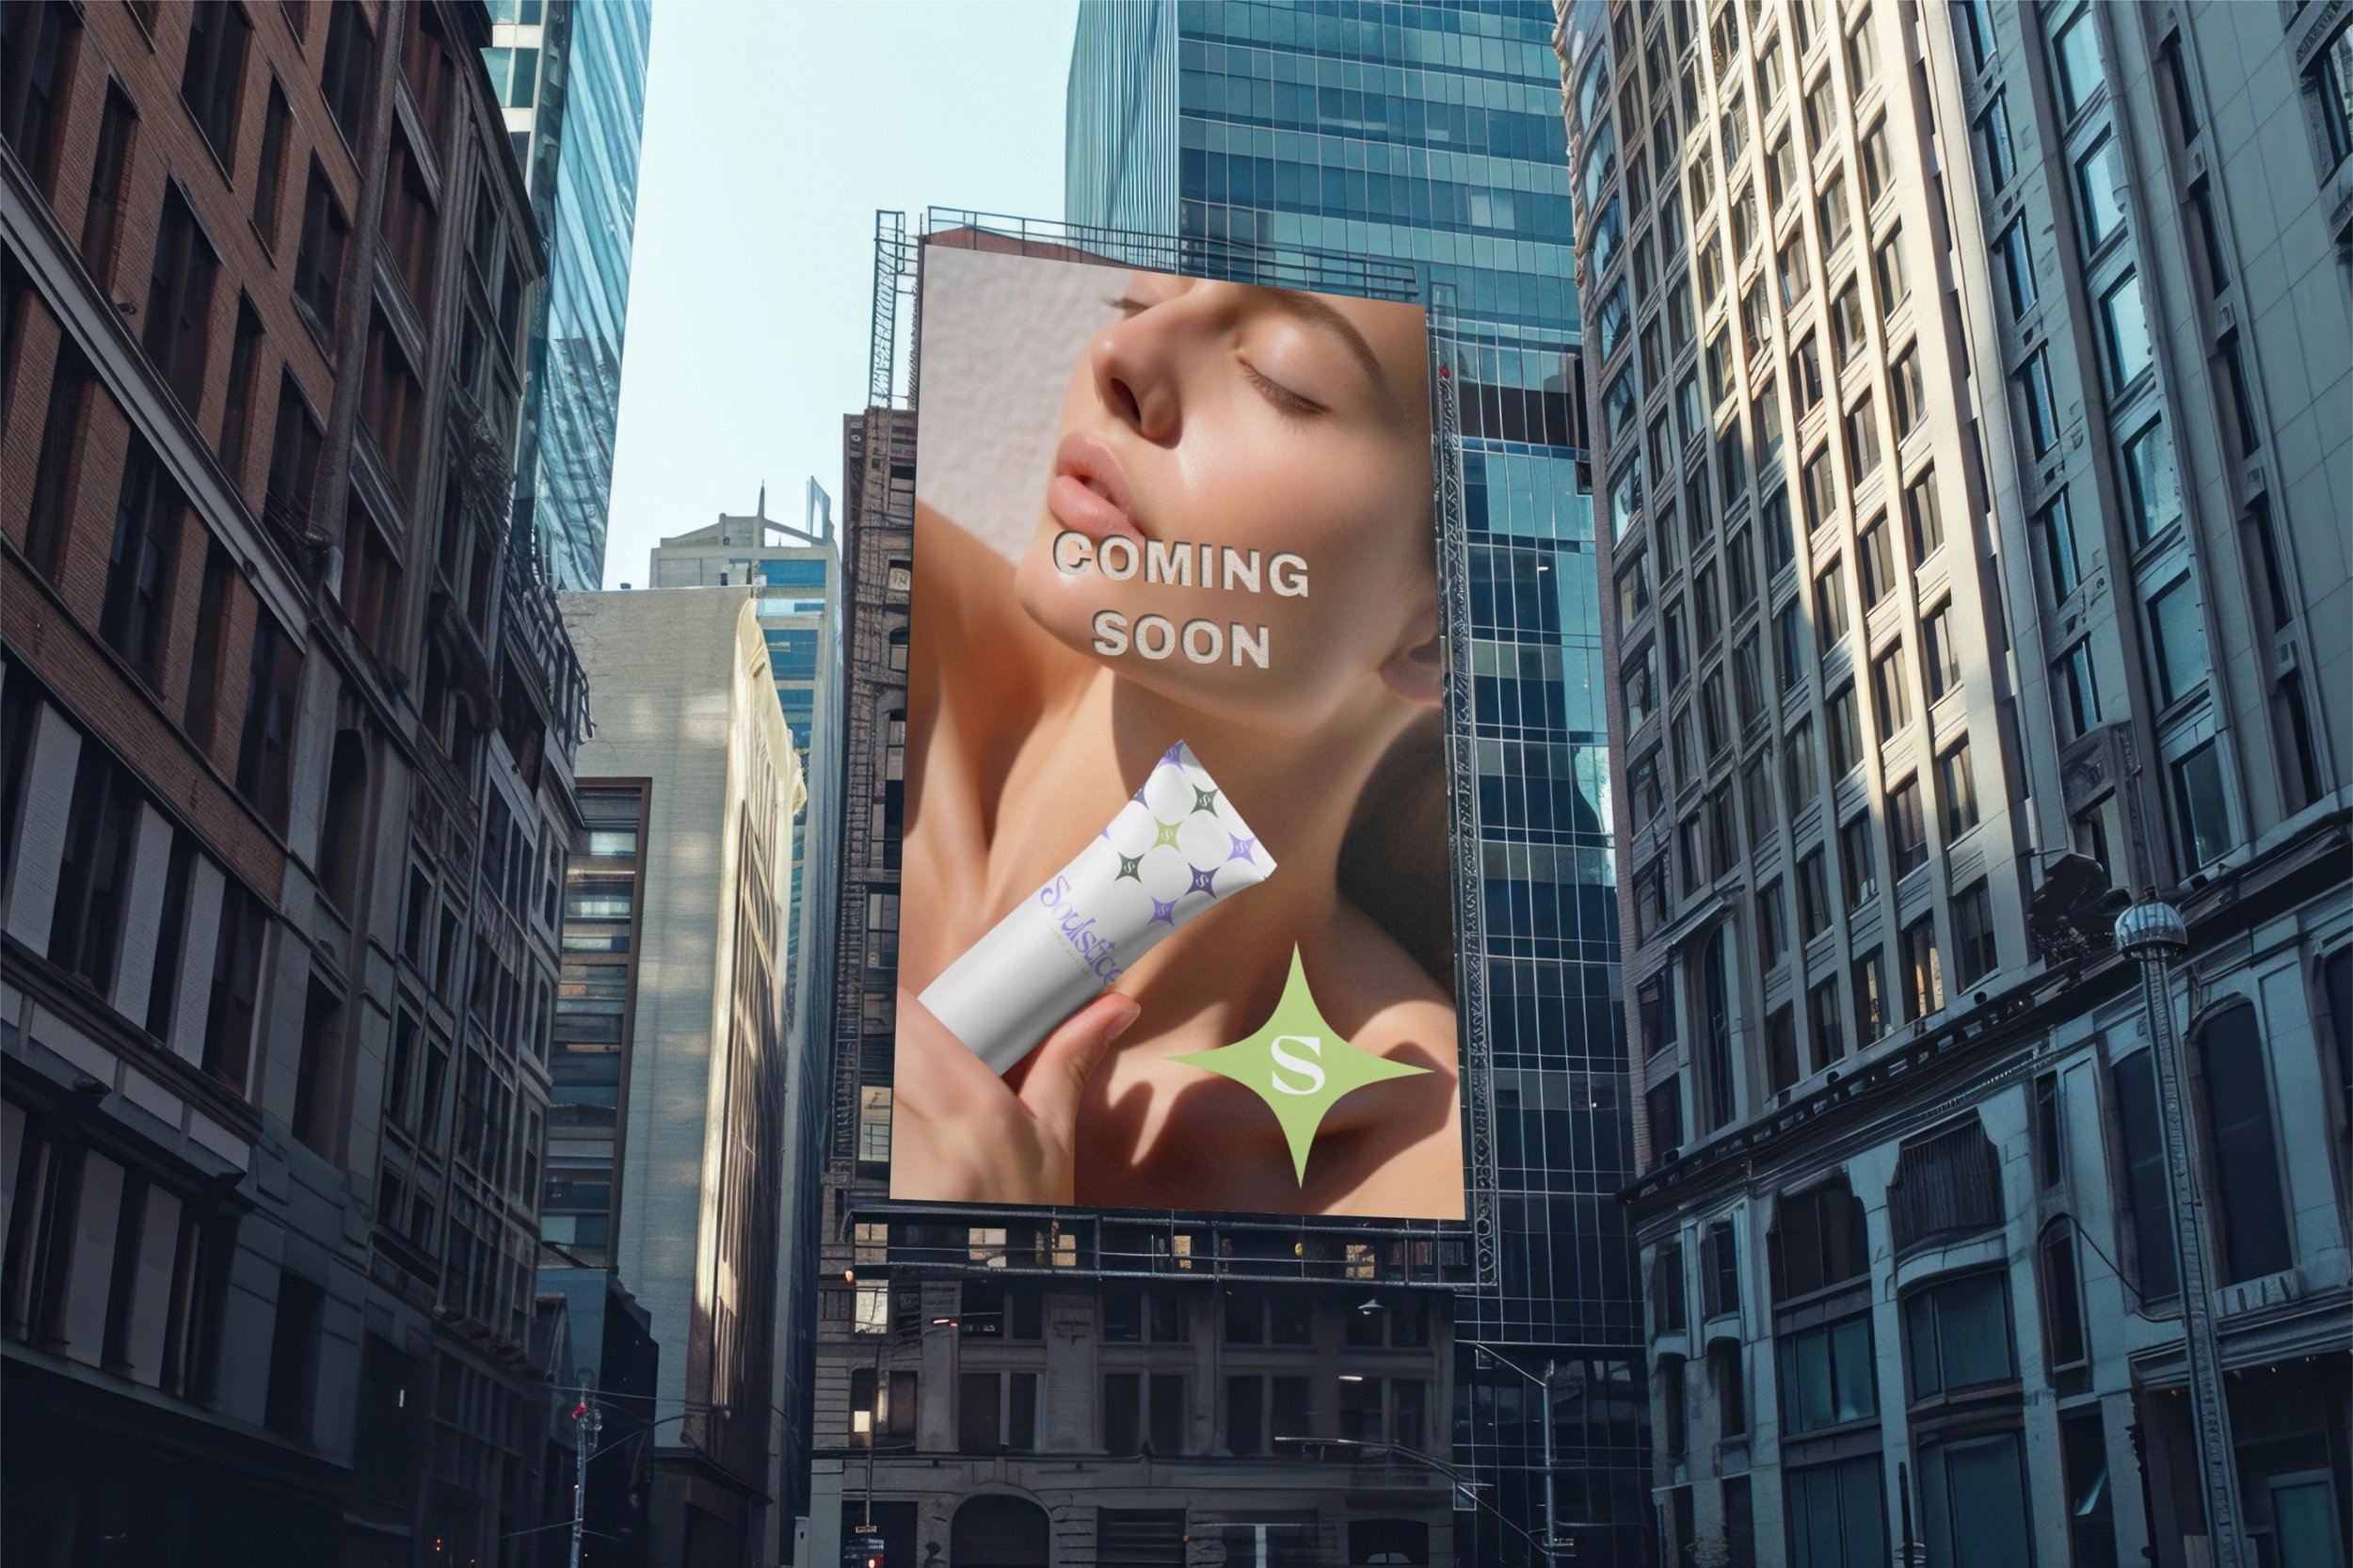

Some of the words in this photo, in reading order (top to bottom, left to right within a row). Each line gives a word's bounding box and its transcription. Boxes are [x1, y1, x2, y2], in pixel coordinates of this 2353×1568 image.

[1053, 530, 1309, 598] COMING
[1092, 609, 1270, 669] SOON
[1199, 794, 1211, 808] S
[1160, 828, 1174, 841] S
[1124, 861, 1135, 873] S
[1195, 874, 1209, 888] S
[1157, 904, 1169, 917] S
[1271, 1035, 1325, 1096] S
